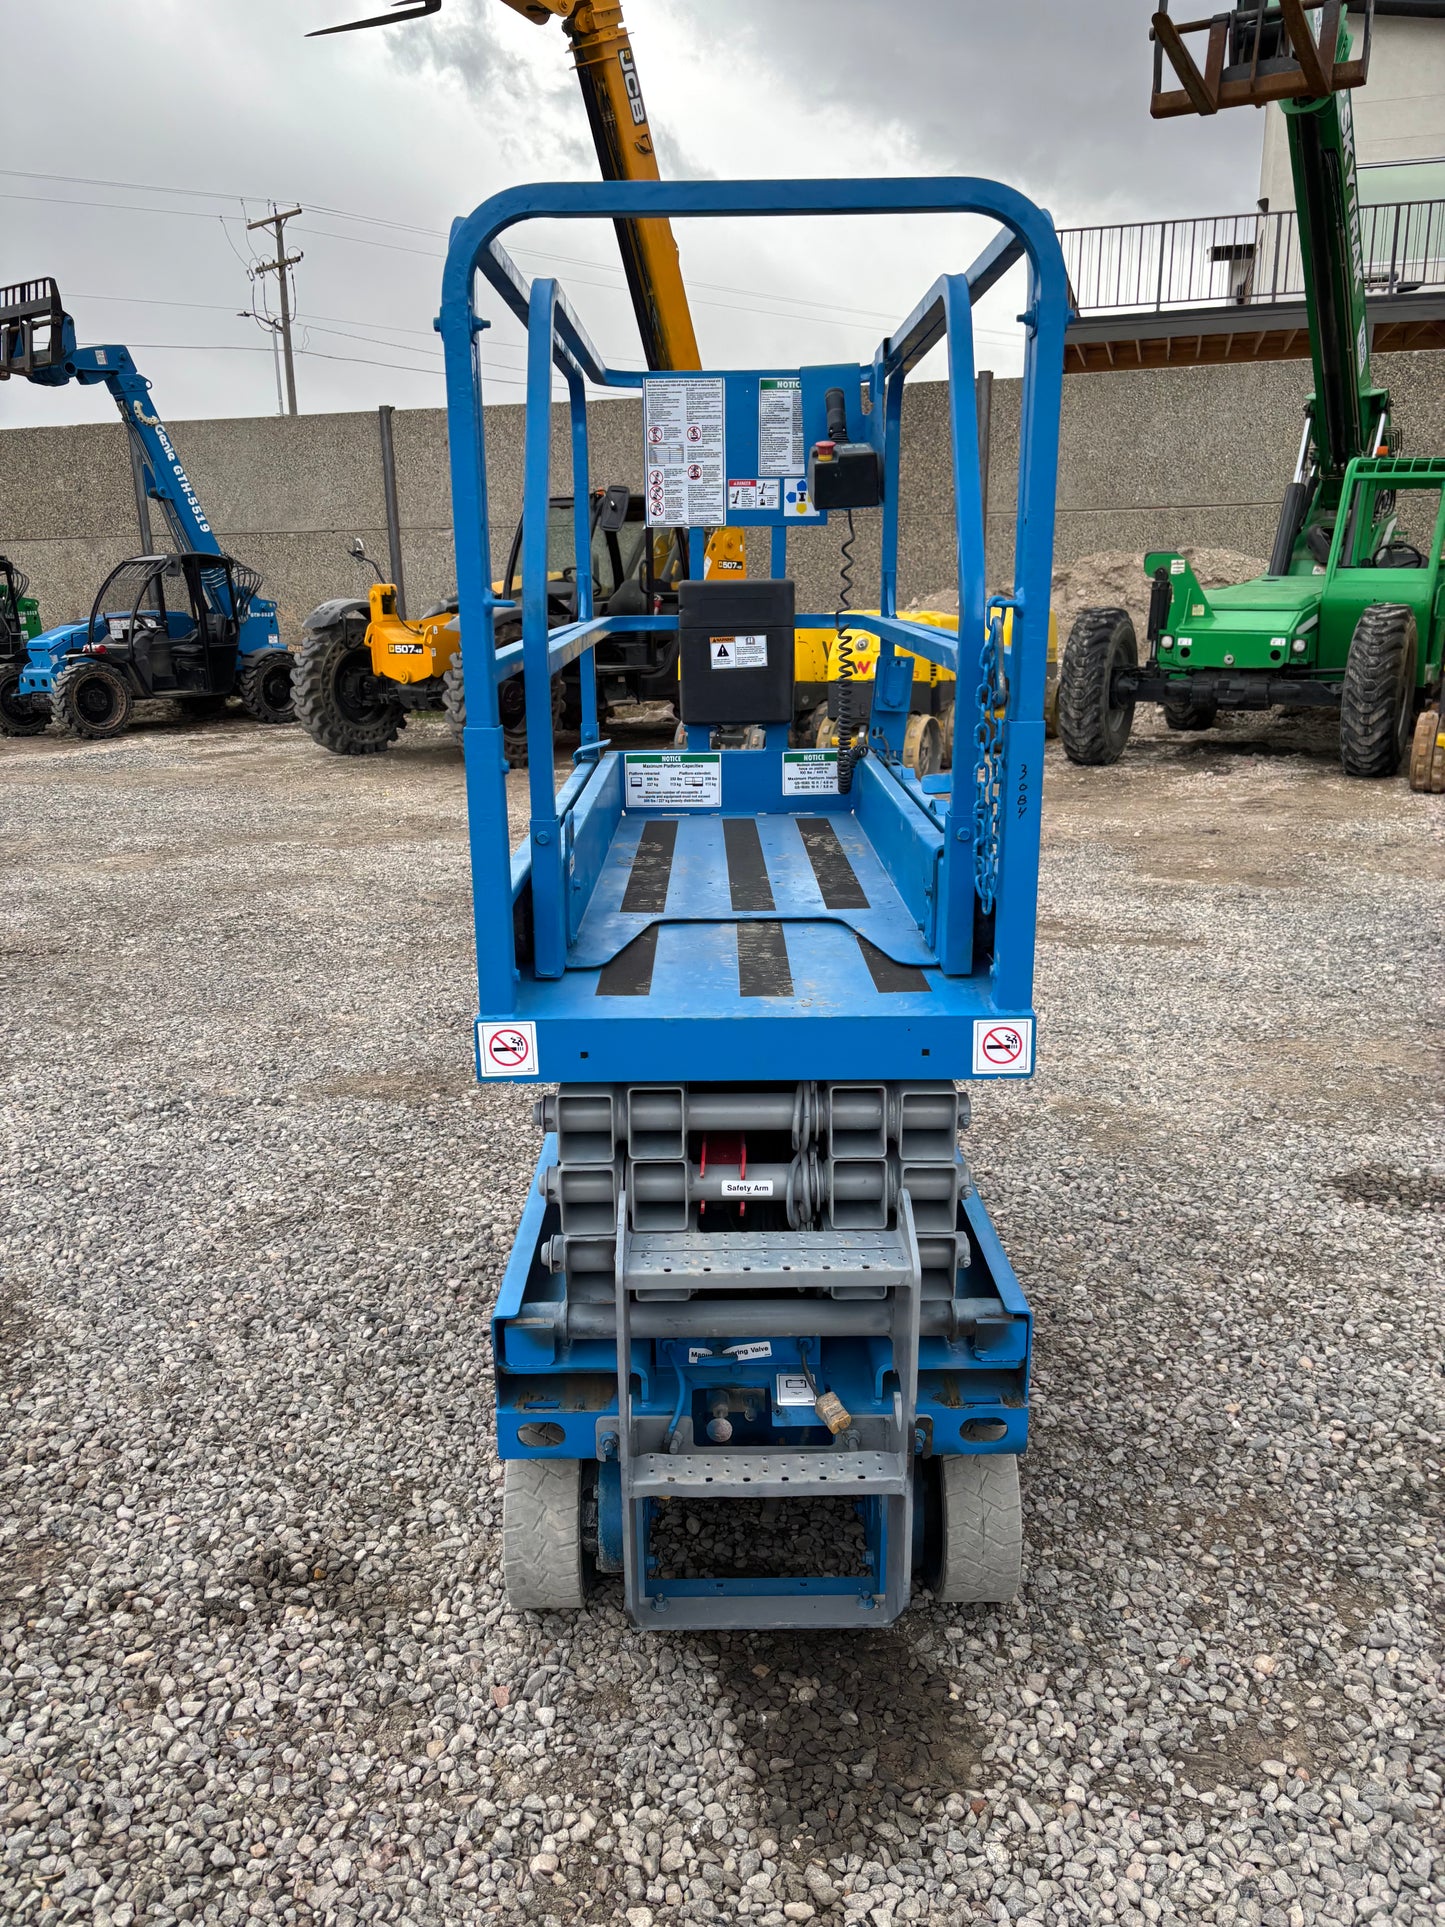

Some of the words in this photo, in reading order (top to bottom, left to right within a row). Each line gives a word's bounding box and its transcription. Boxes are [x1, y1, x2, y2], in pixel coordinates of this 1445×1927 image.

[619, 50, 645, 124] JCB
[1340, 102, 1363, 294] SKYTRAK
[154, 424, 176, 462] Genie
[173, 465, 210, 533] GTH-5519
[1017, 763, 1028, 820] 3084
